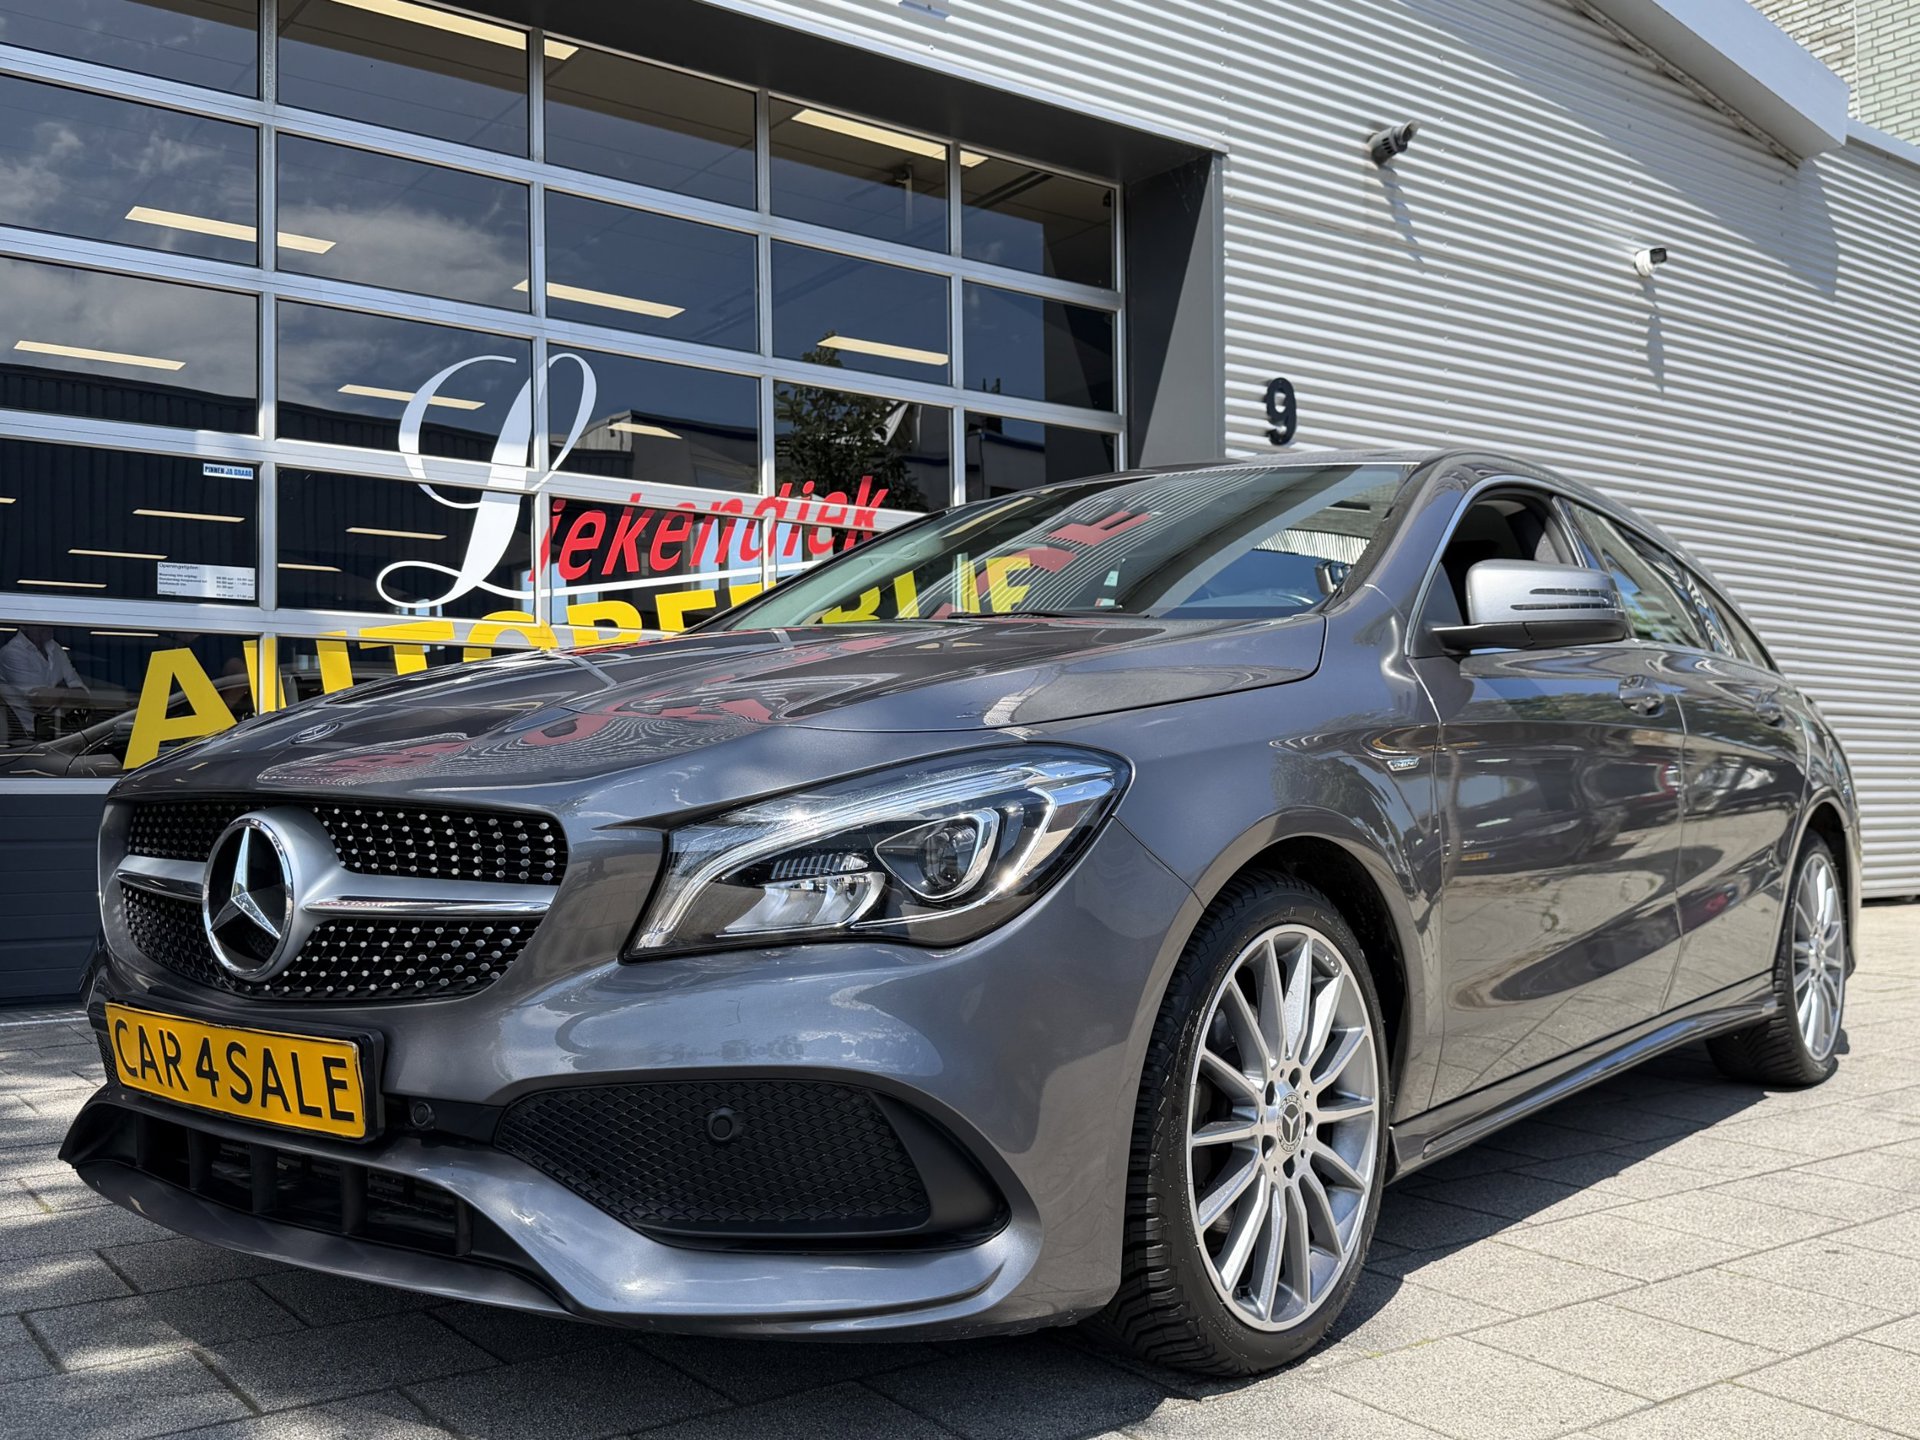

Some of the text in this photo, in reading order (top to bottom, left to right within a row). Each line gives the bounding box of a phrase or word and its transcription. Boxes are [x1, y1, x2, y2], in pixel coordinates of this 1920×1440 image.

[1266, 377, 1297, 446] 9
[114, 1018, 356, 1122] CAR 4 SALE
